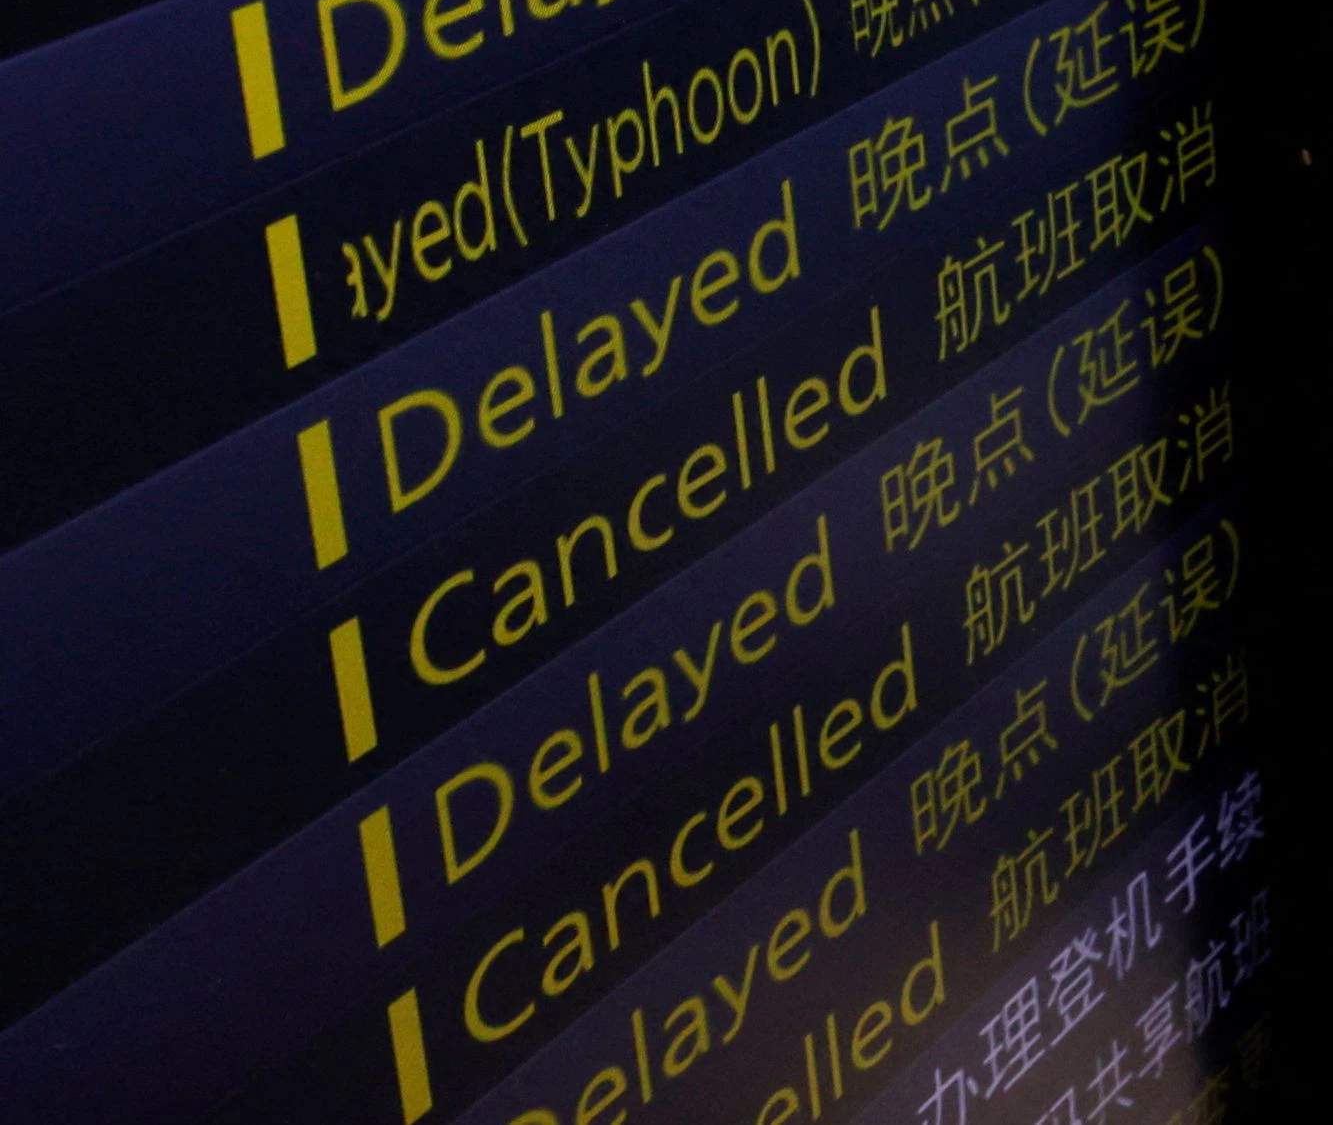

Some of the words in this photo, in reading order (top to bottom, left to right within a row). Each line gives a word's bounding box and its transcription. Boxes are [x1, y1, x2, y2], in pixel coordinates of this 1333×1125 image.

[375, 178, 802, 515] Delayed
[409, 305, 888, 686] Cancelled
[934, 101, 1217, 361] 航班取消
[433, 514, 836, 886] Delayed
[463, 622, 918, 1044] Cancelled
[962, 386, 1233, 666] 航班取消
[990, 658, 1247, 954] 航班取消
[506, 828, 869, 1125] elayed
